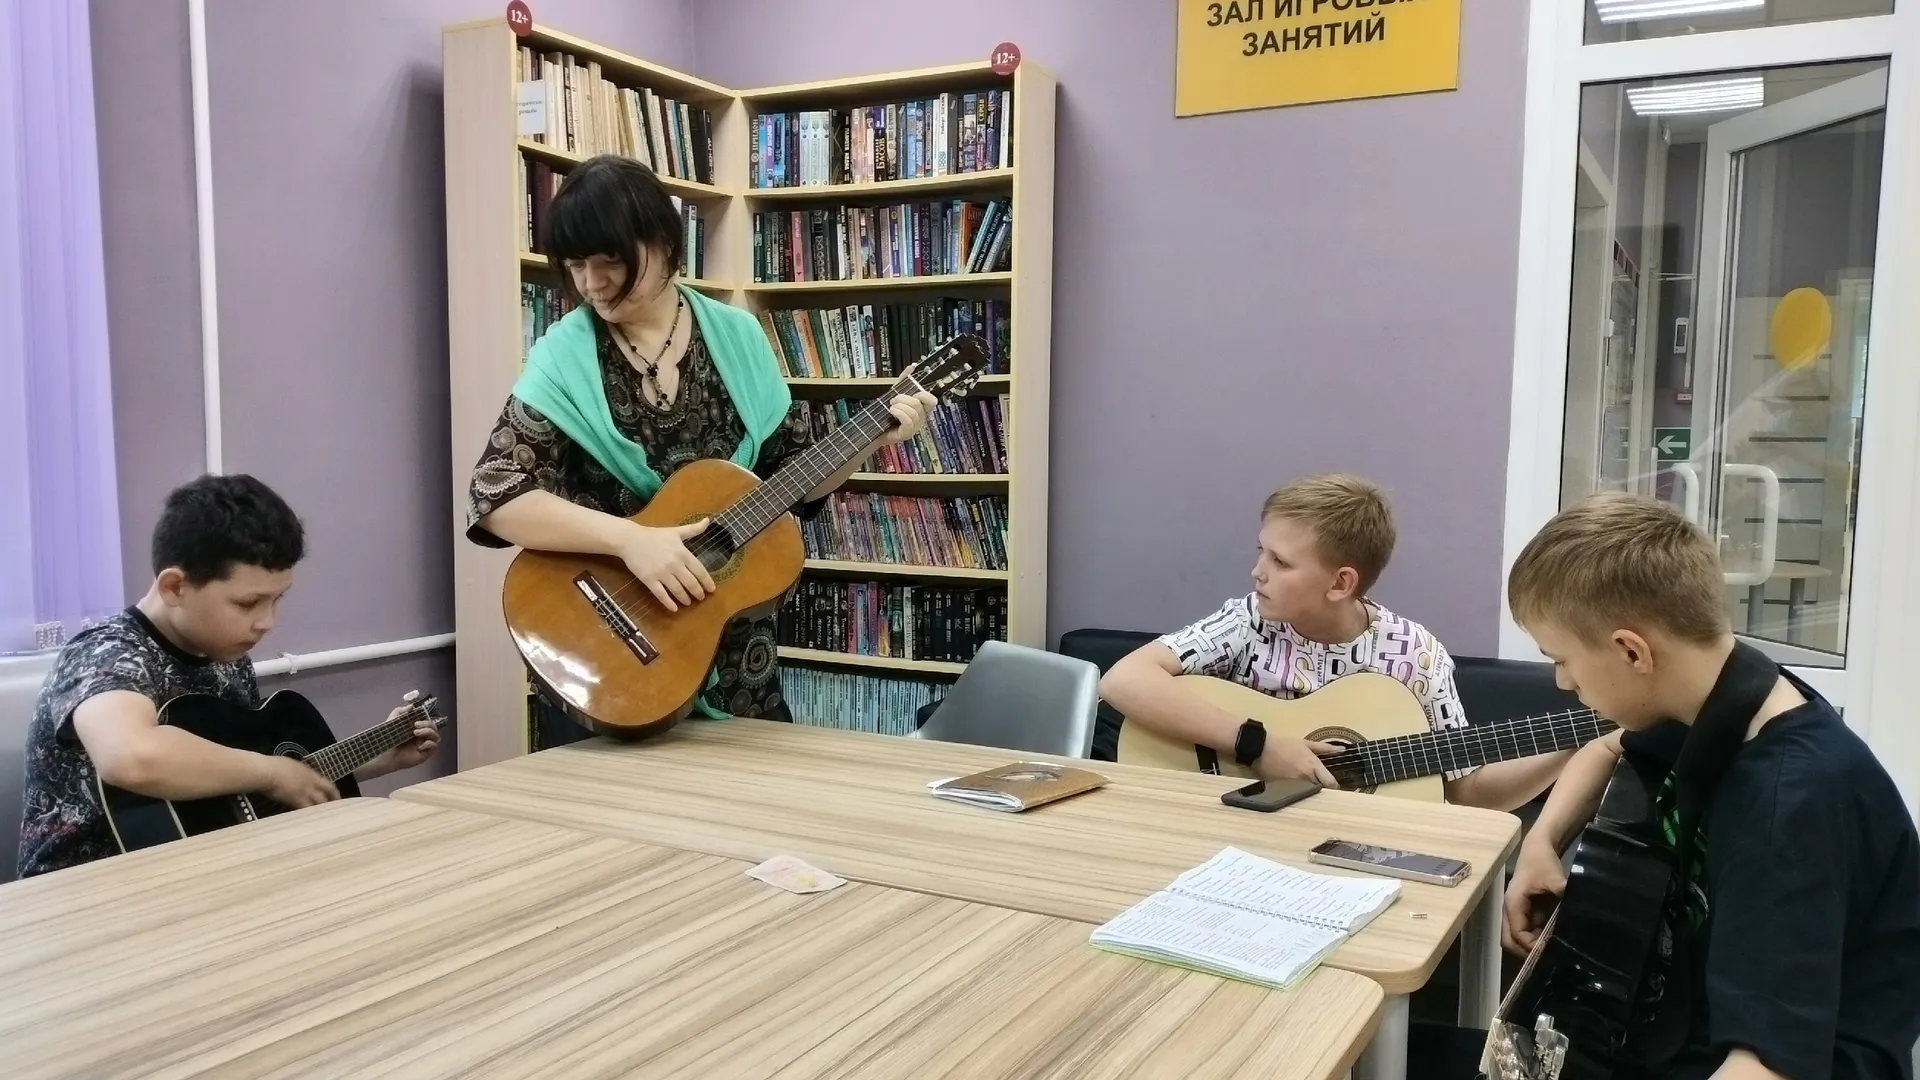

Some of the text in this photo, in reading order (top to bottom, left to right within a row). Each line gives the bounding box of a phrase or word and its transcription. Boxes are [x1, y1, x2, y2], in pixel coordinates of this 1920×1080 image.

[511, 9, 529, 24] 12+
[1207, 0, 1263, 27] ЗАЛ
[1242, 11, 1385, 57] ЗАНЯТИЙ
[996, 52, 1016, 65] 12+
